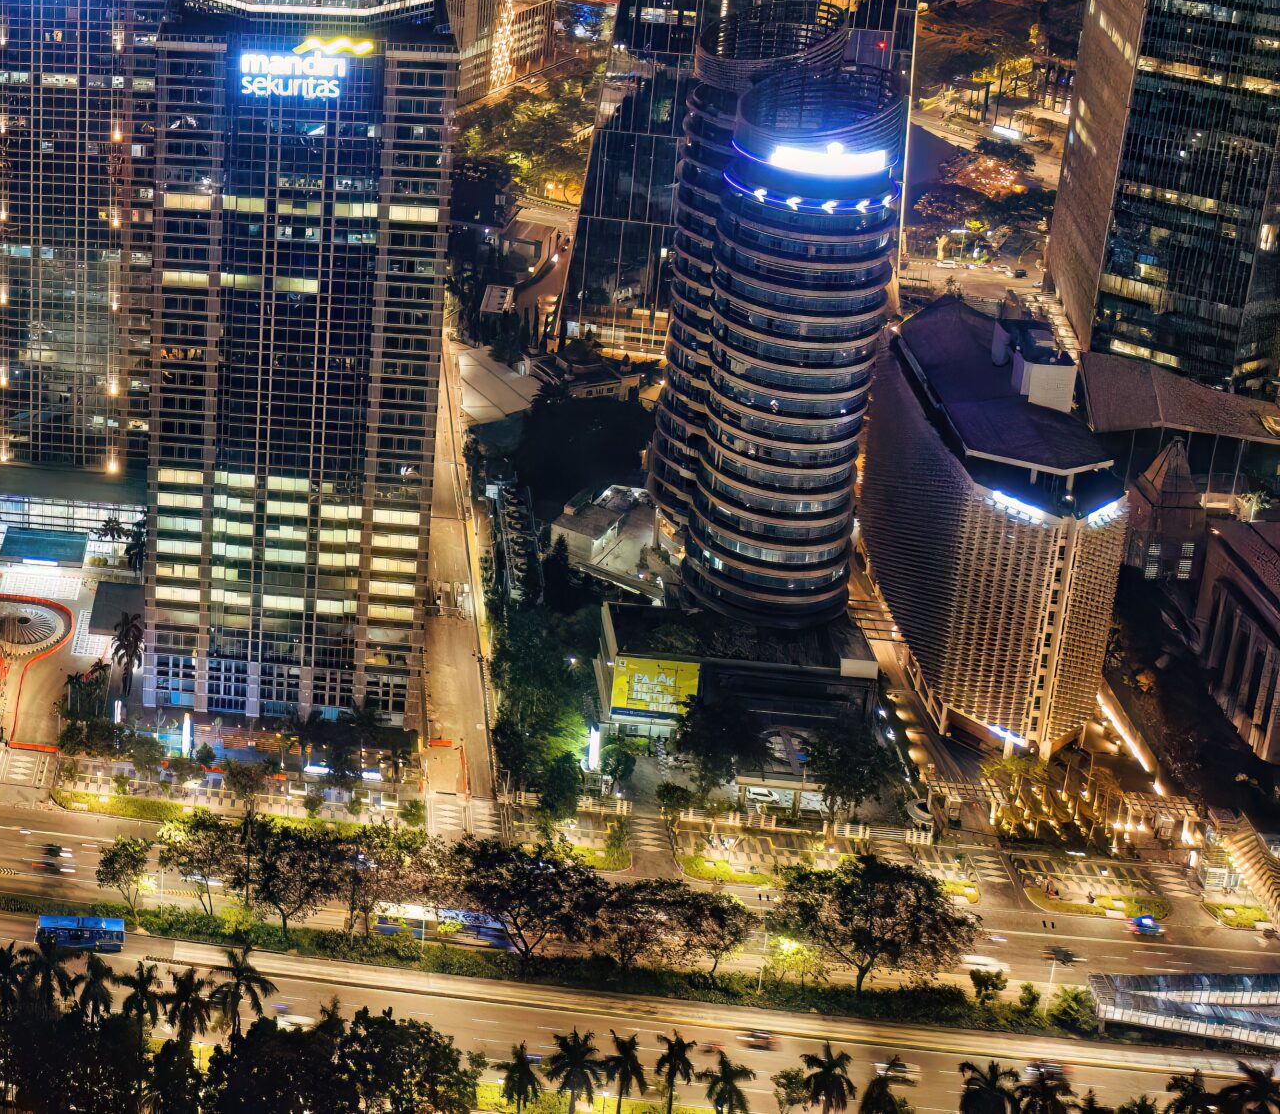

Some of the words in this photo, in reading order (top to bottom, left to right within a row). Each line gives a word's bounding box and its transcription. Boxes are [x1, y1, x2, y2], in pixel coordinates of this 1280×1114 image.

[241, 50, 346, 77] mandiri
[241, 73, 340, 99] sekuritas
[634, 672, 675, 687] PAJAK
